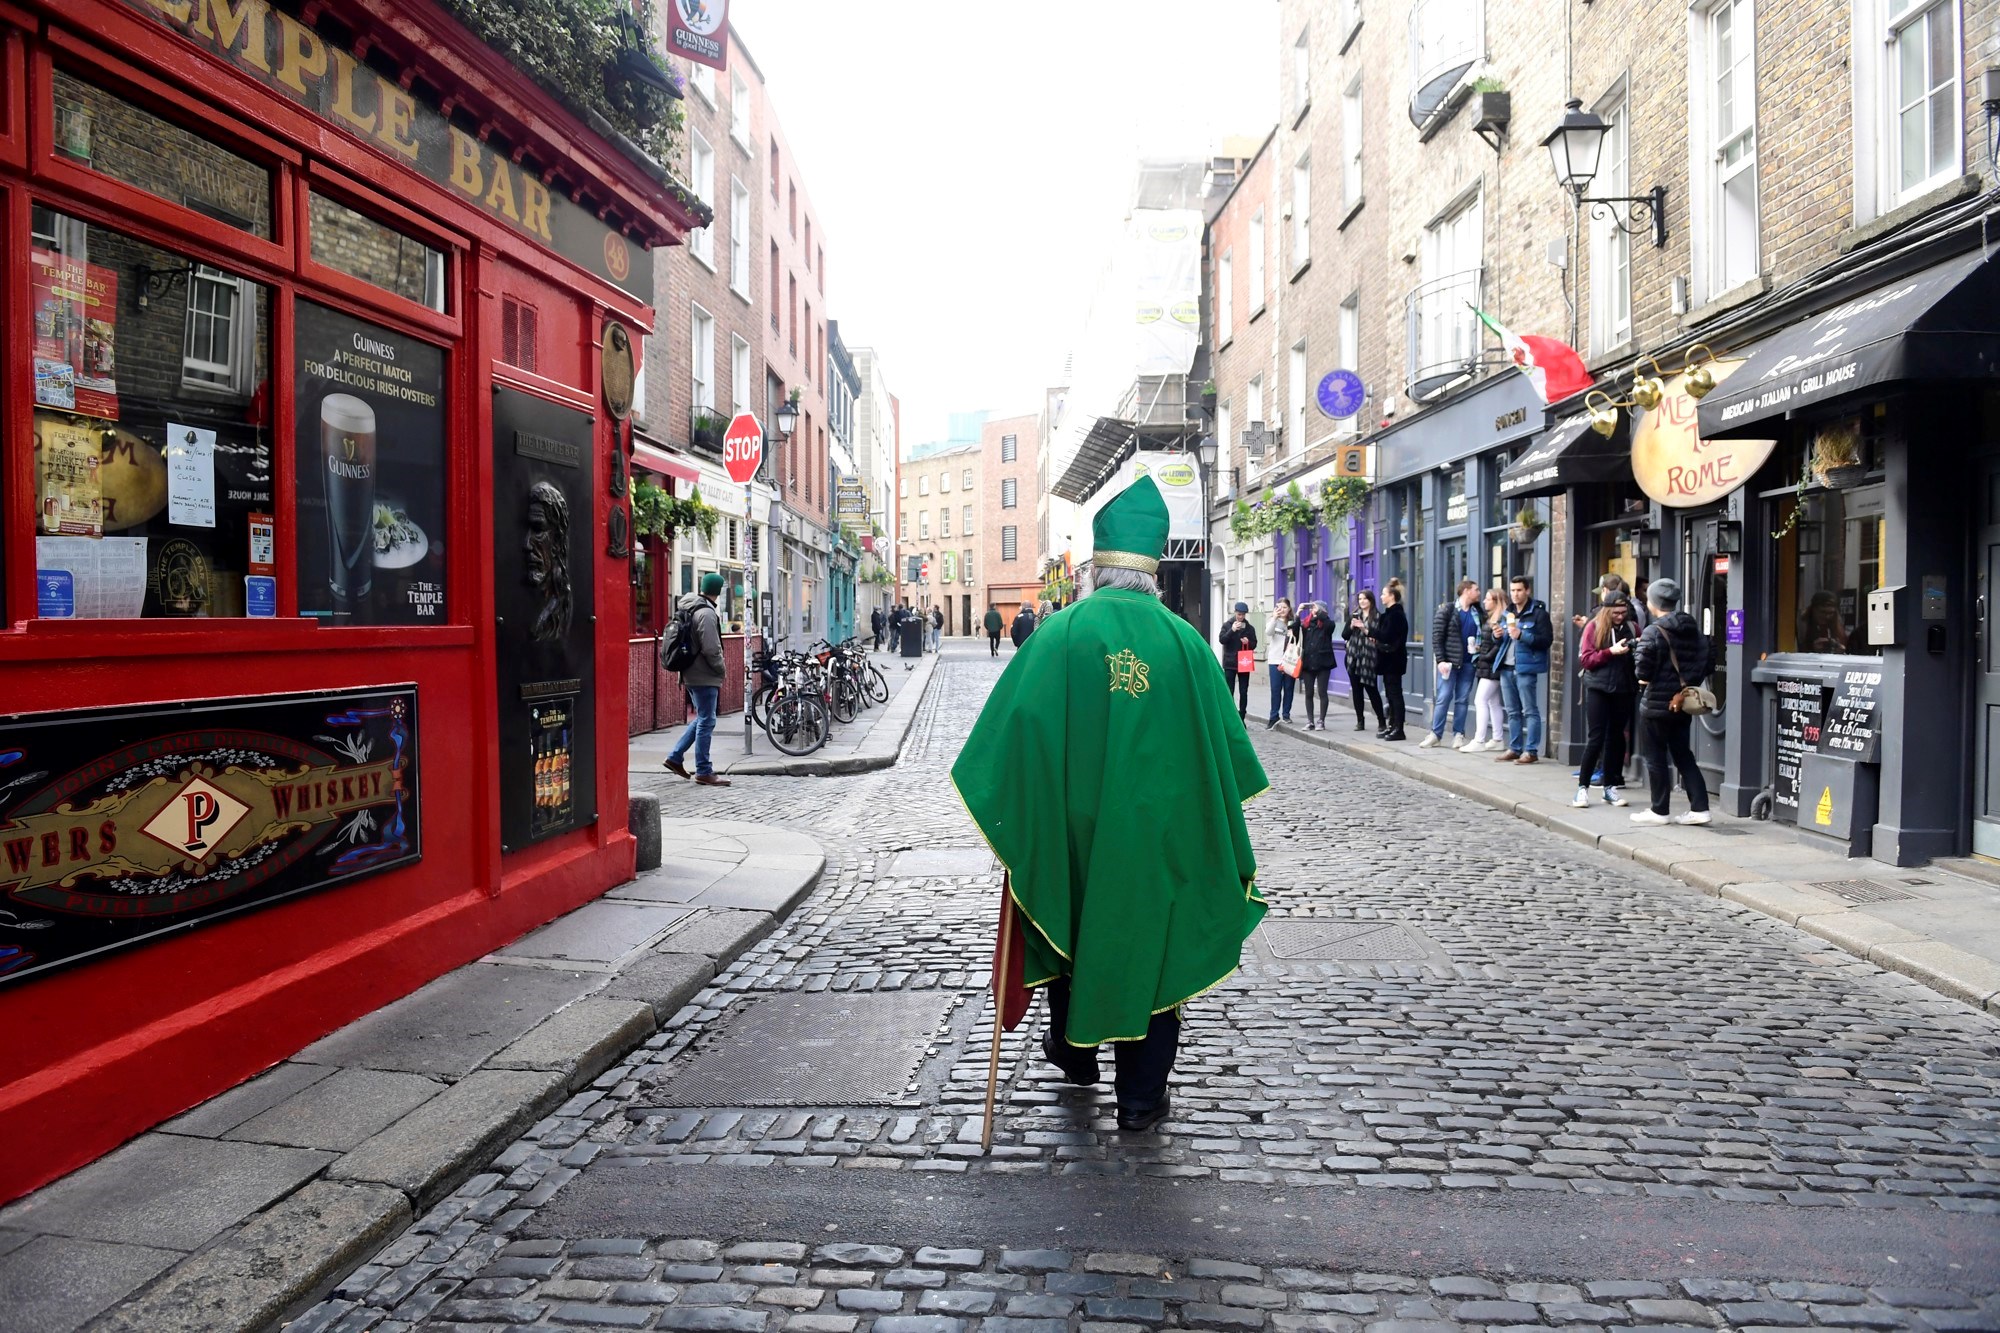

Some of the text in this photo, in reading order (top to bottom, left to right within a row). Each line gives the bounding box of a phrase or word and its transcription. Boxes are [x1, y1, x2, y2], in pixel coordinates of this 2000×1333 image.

[676, 29, 719, 51] GUINNESS
[682, 40, 697, 51] good
[698, 44, 707, 53] for
[707, 49, 719, 58] you
[449, 123, 552, 241] BAR
[609, 242, 624, 272] 48
[41, 265, 106, 294] TEMPLE BAR
[66, 264, 83, 275] THE
[353, 332, 395, 361] GUINNESS
[333, 349, 412, 383] A PERFECT MATCH
[304, 359, 436, 408] FOR DELICIOUS IRISH OYSTERS
[1721, 398, 1754, 421] MEXICAN
[1761, 386, 1790, 409] ITALIAN
[1801, 375, 1824, 394] GRILL
[1826, 362, 1857, 386] HOUSE
[48, 453, 86, 466] WHISKEY
[726, 435, 760, 462] STOP
[48, 462, 84, 477] RAFFLE
[328, 455, 370, 479] GUINNESS
[1667, 454, 1738, 497] ROME
[407, 590, 443, 604] TEMPLE
[417, 581, 433, 592] THE
[416, 604, 435, 616] BAR
[1844, 671, 1868, 684] EARLY
[1804, 684, 1822, 696] ROME
[540, 715, 556, 725] TEMPLE
[1827, 718, 1835, 733] 2
[147, 735, 203, 757] LANE
[1779, 763, 1797, 779] EARLY
[270, 772, 383, 819] WHISKEY
[181, 791, 221, 851] P
[0, 820, 117, 875] WERS
[66, 893, 151, 914] PURE
